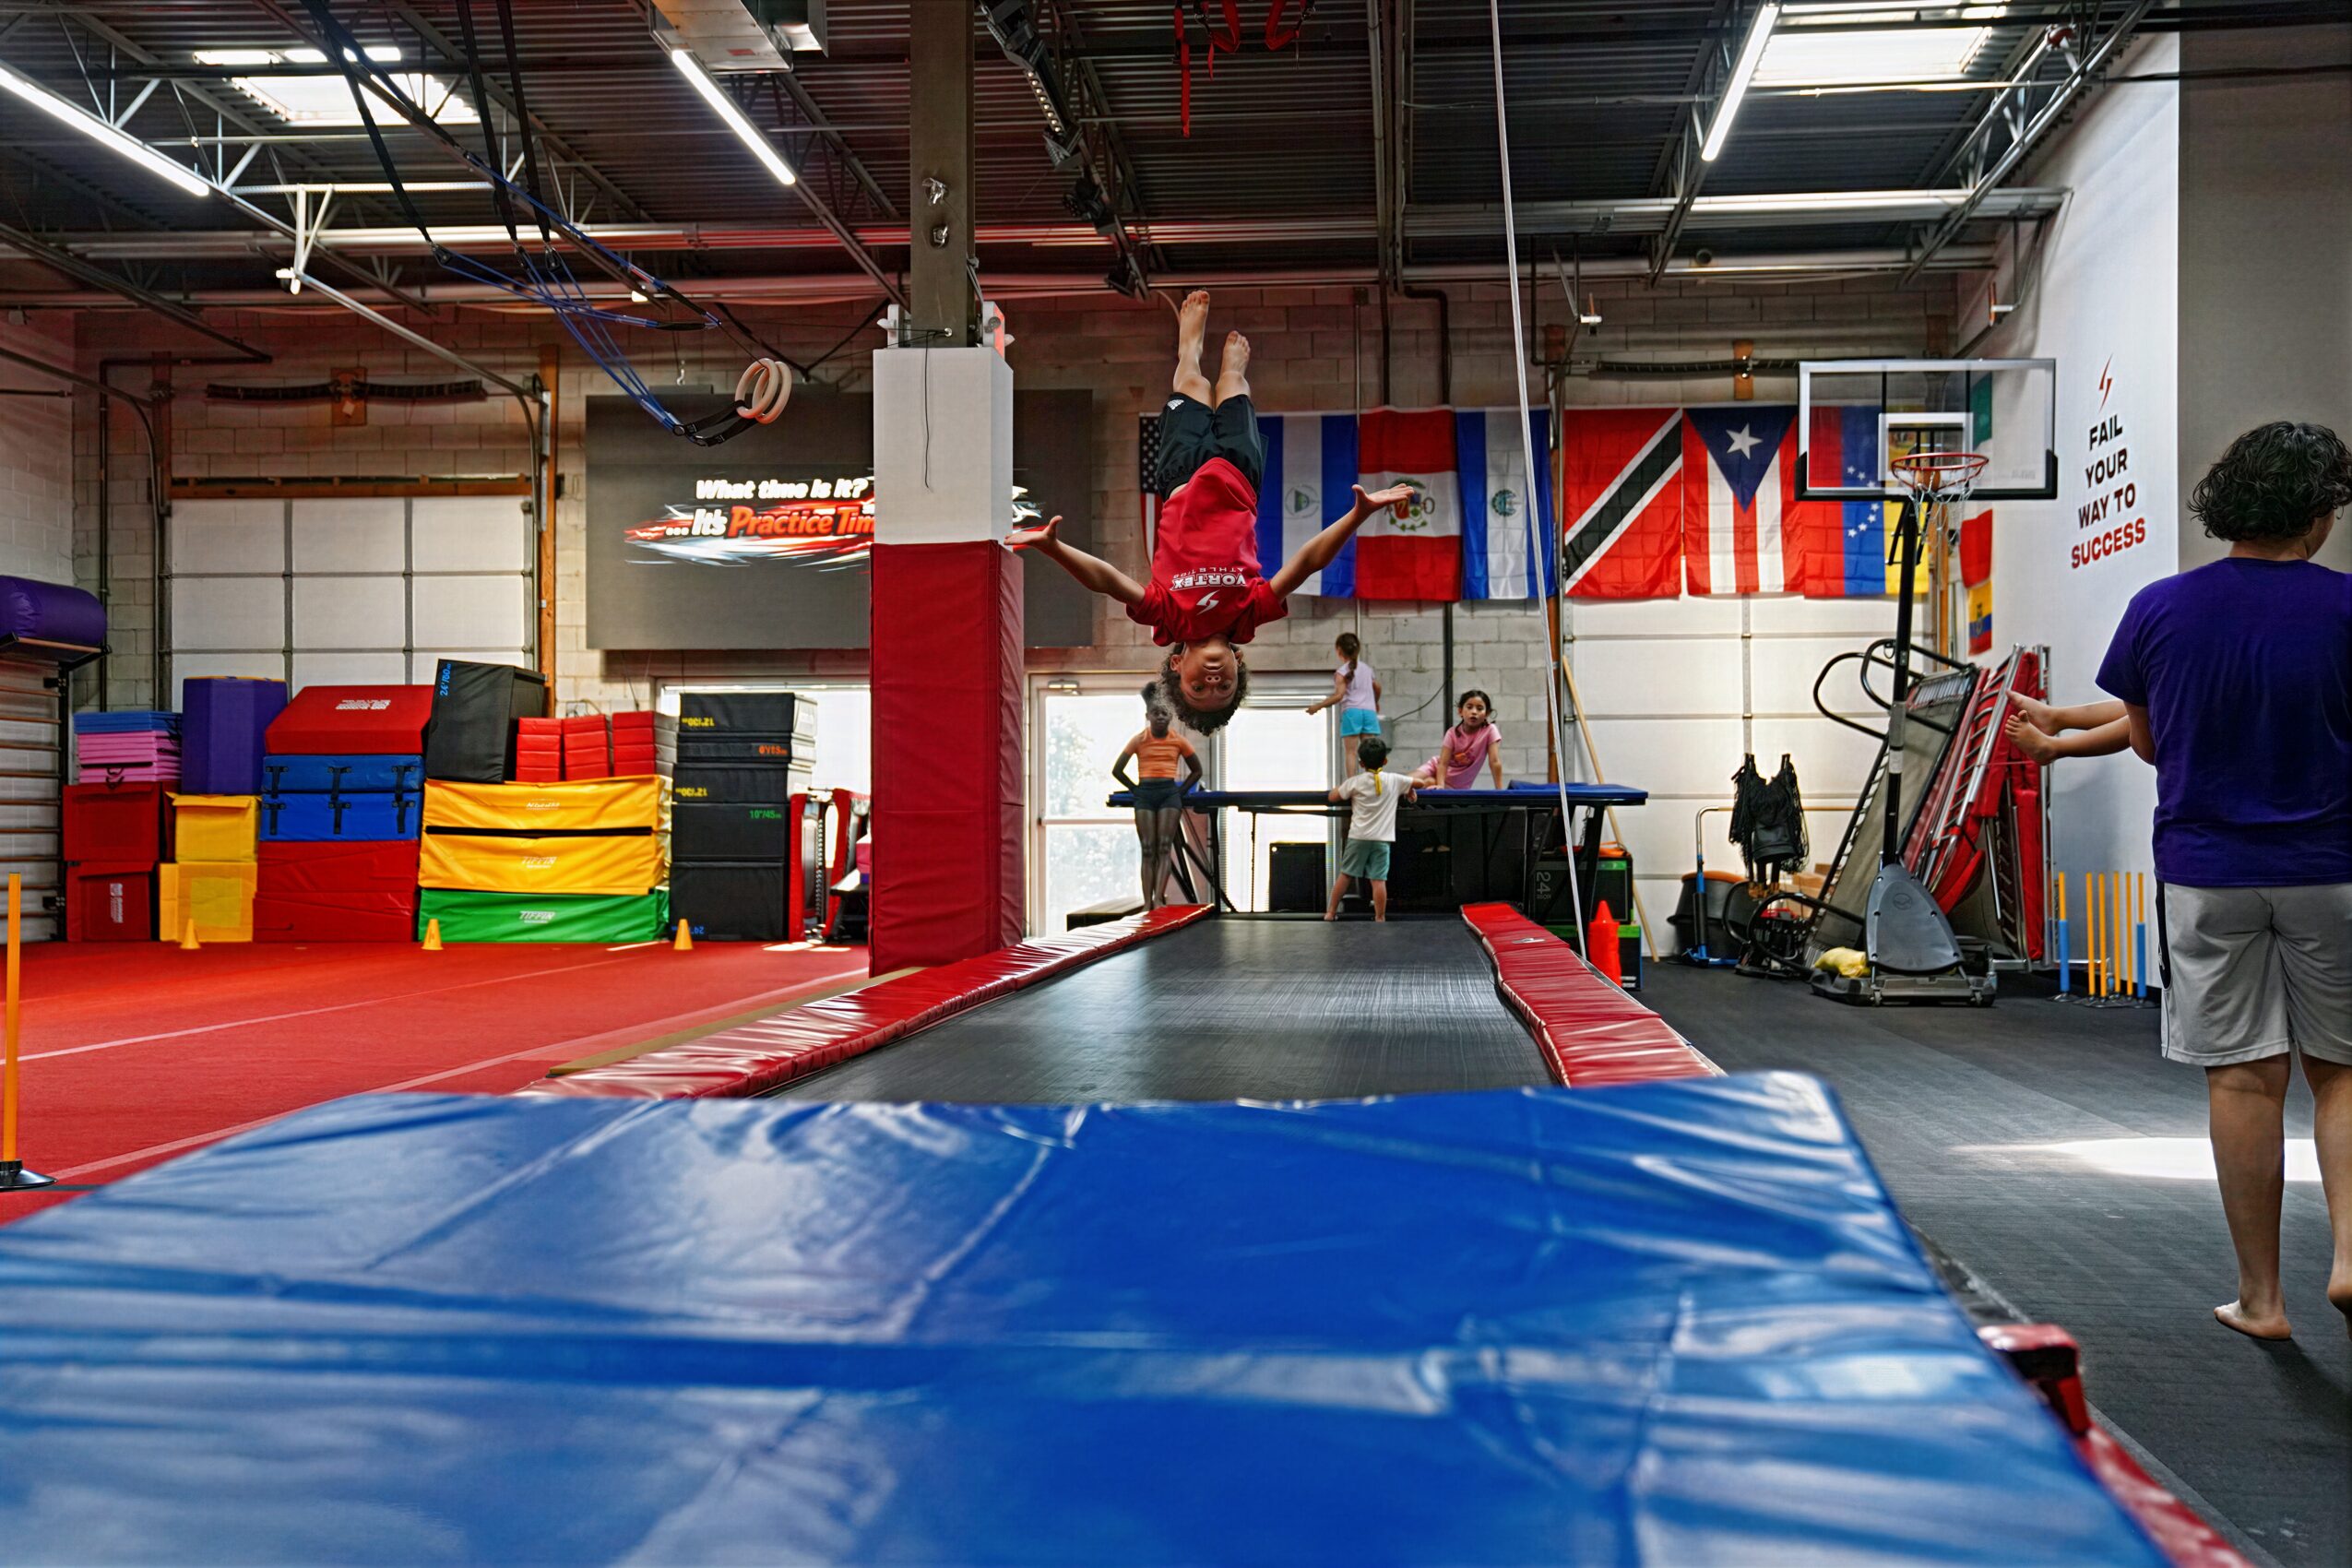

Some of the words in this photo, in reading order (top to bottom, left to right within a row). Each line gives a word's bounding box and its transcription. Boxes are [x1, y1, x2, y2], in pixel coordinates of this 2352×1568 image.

[2089, 414, 2123, 451] FAIL
[2085, 447, 2128, 488] YOUR
[696, 480, 755, 499] What
[758, 480, 808, 499] time
[2078, 494, 2109, 529] WAY
[2114, 482, 2135, 513] TO
[728, 505, 834, 538] Practice
[2071, 517, 2145, 569] SUCCESS
[1170, 573, 1247, 591] VORTEX
[1536, 872, 1550, 894] 24
